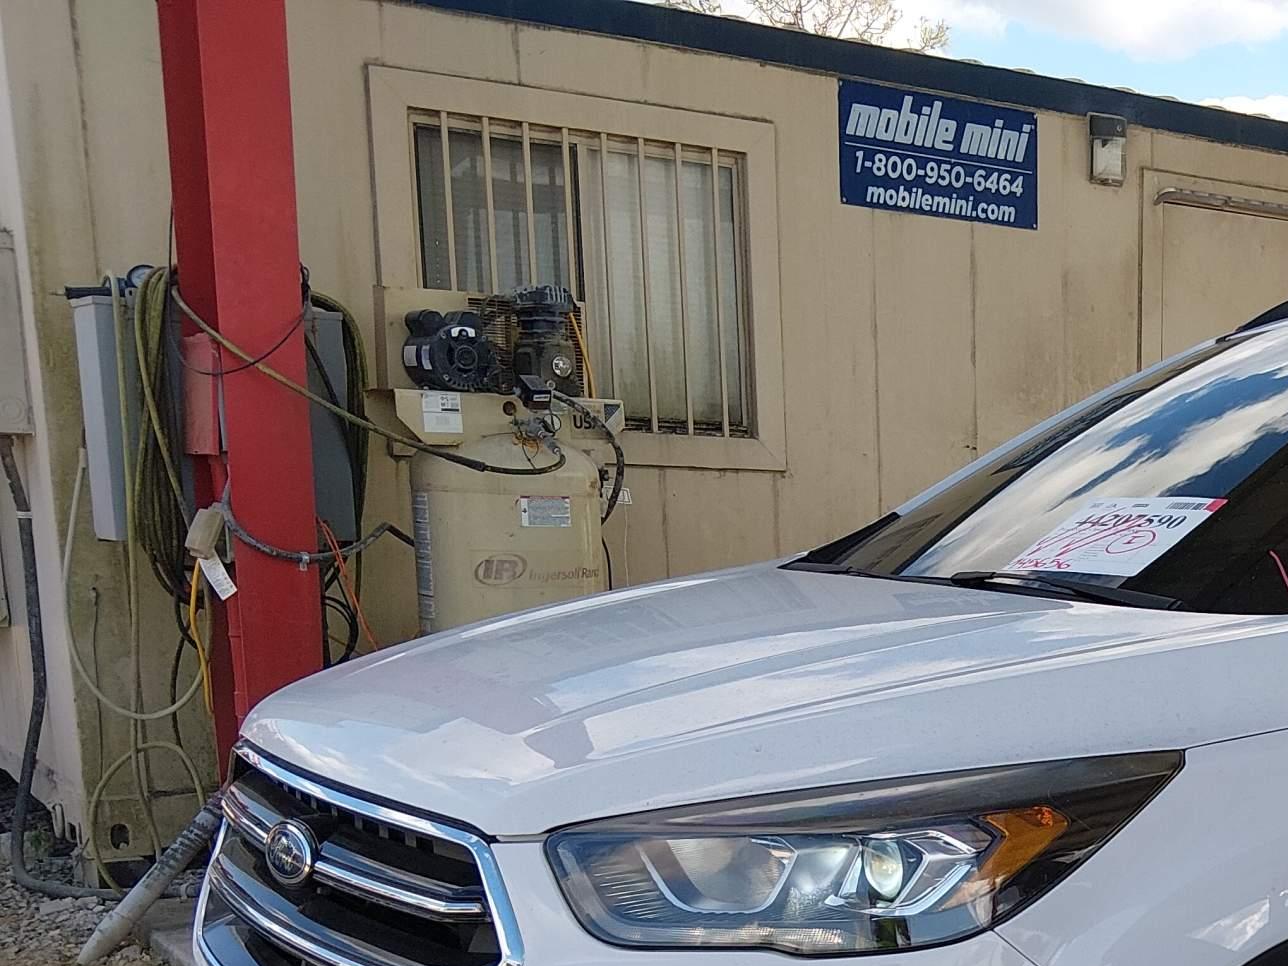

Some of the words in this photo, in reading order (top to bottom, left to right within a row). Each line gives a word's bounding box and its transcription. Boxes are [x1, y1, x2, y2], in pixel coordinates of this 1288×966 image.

[845, 95, 957, 151] mobile
[959, 119, 1032, 163] mini
[855, 150, 1024, 197] 1-800-950-6464
[866, 185, 1016, 223] mobilemini.com
